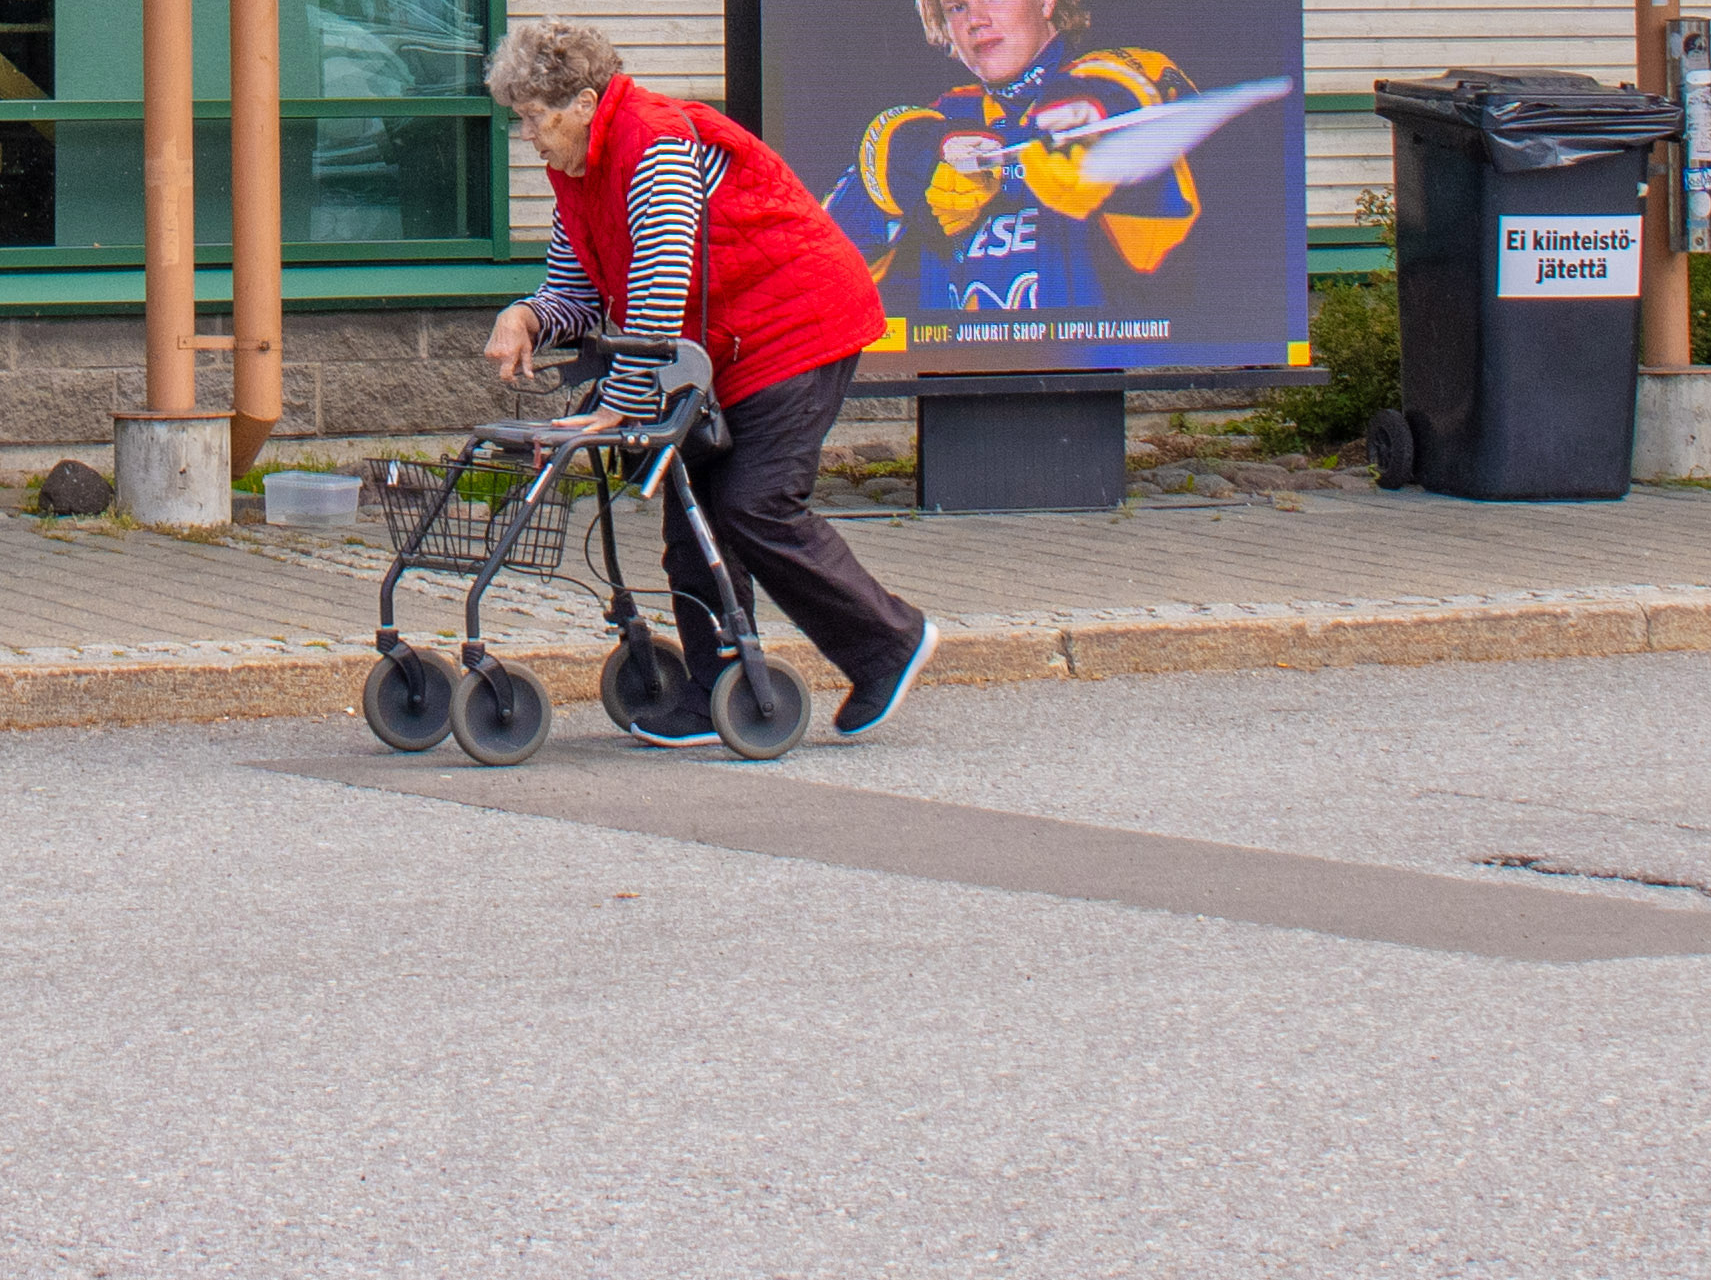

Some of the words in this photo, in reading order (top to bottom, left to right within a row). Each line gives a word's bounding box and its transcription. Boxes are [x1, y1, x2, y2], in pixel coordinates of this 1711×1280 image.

[968, 208, 1038, 258] ESE
[1506, 228, 1527, 253] Ei
[1531, 226, 1637, 254] kiinteistö-
[1535, 255, 1609, 284] jätettä
[913, 325, 953, 343] LIPUT:
[956, 323, 1010, 342] JUKURIT
[1013, 322, 1047, 341] SHOP
[1057, 319, 1170, 341] LIPPU.FI/JUKURIT
